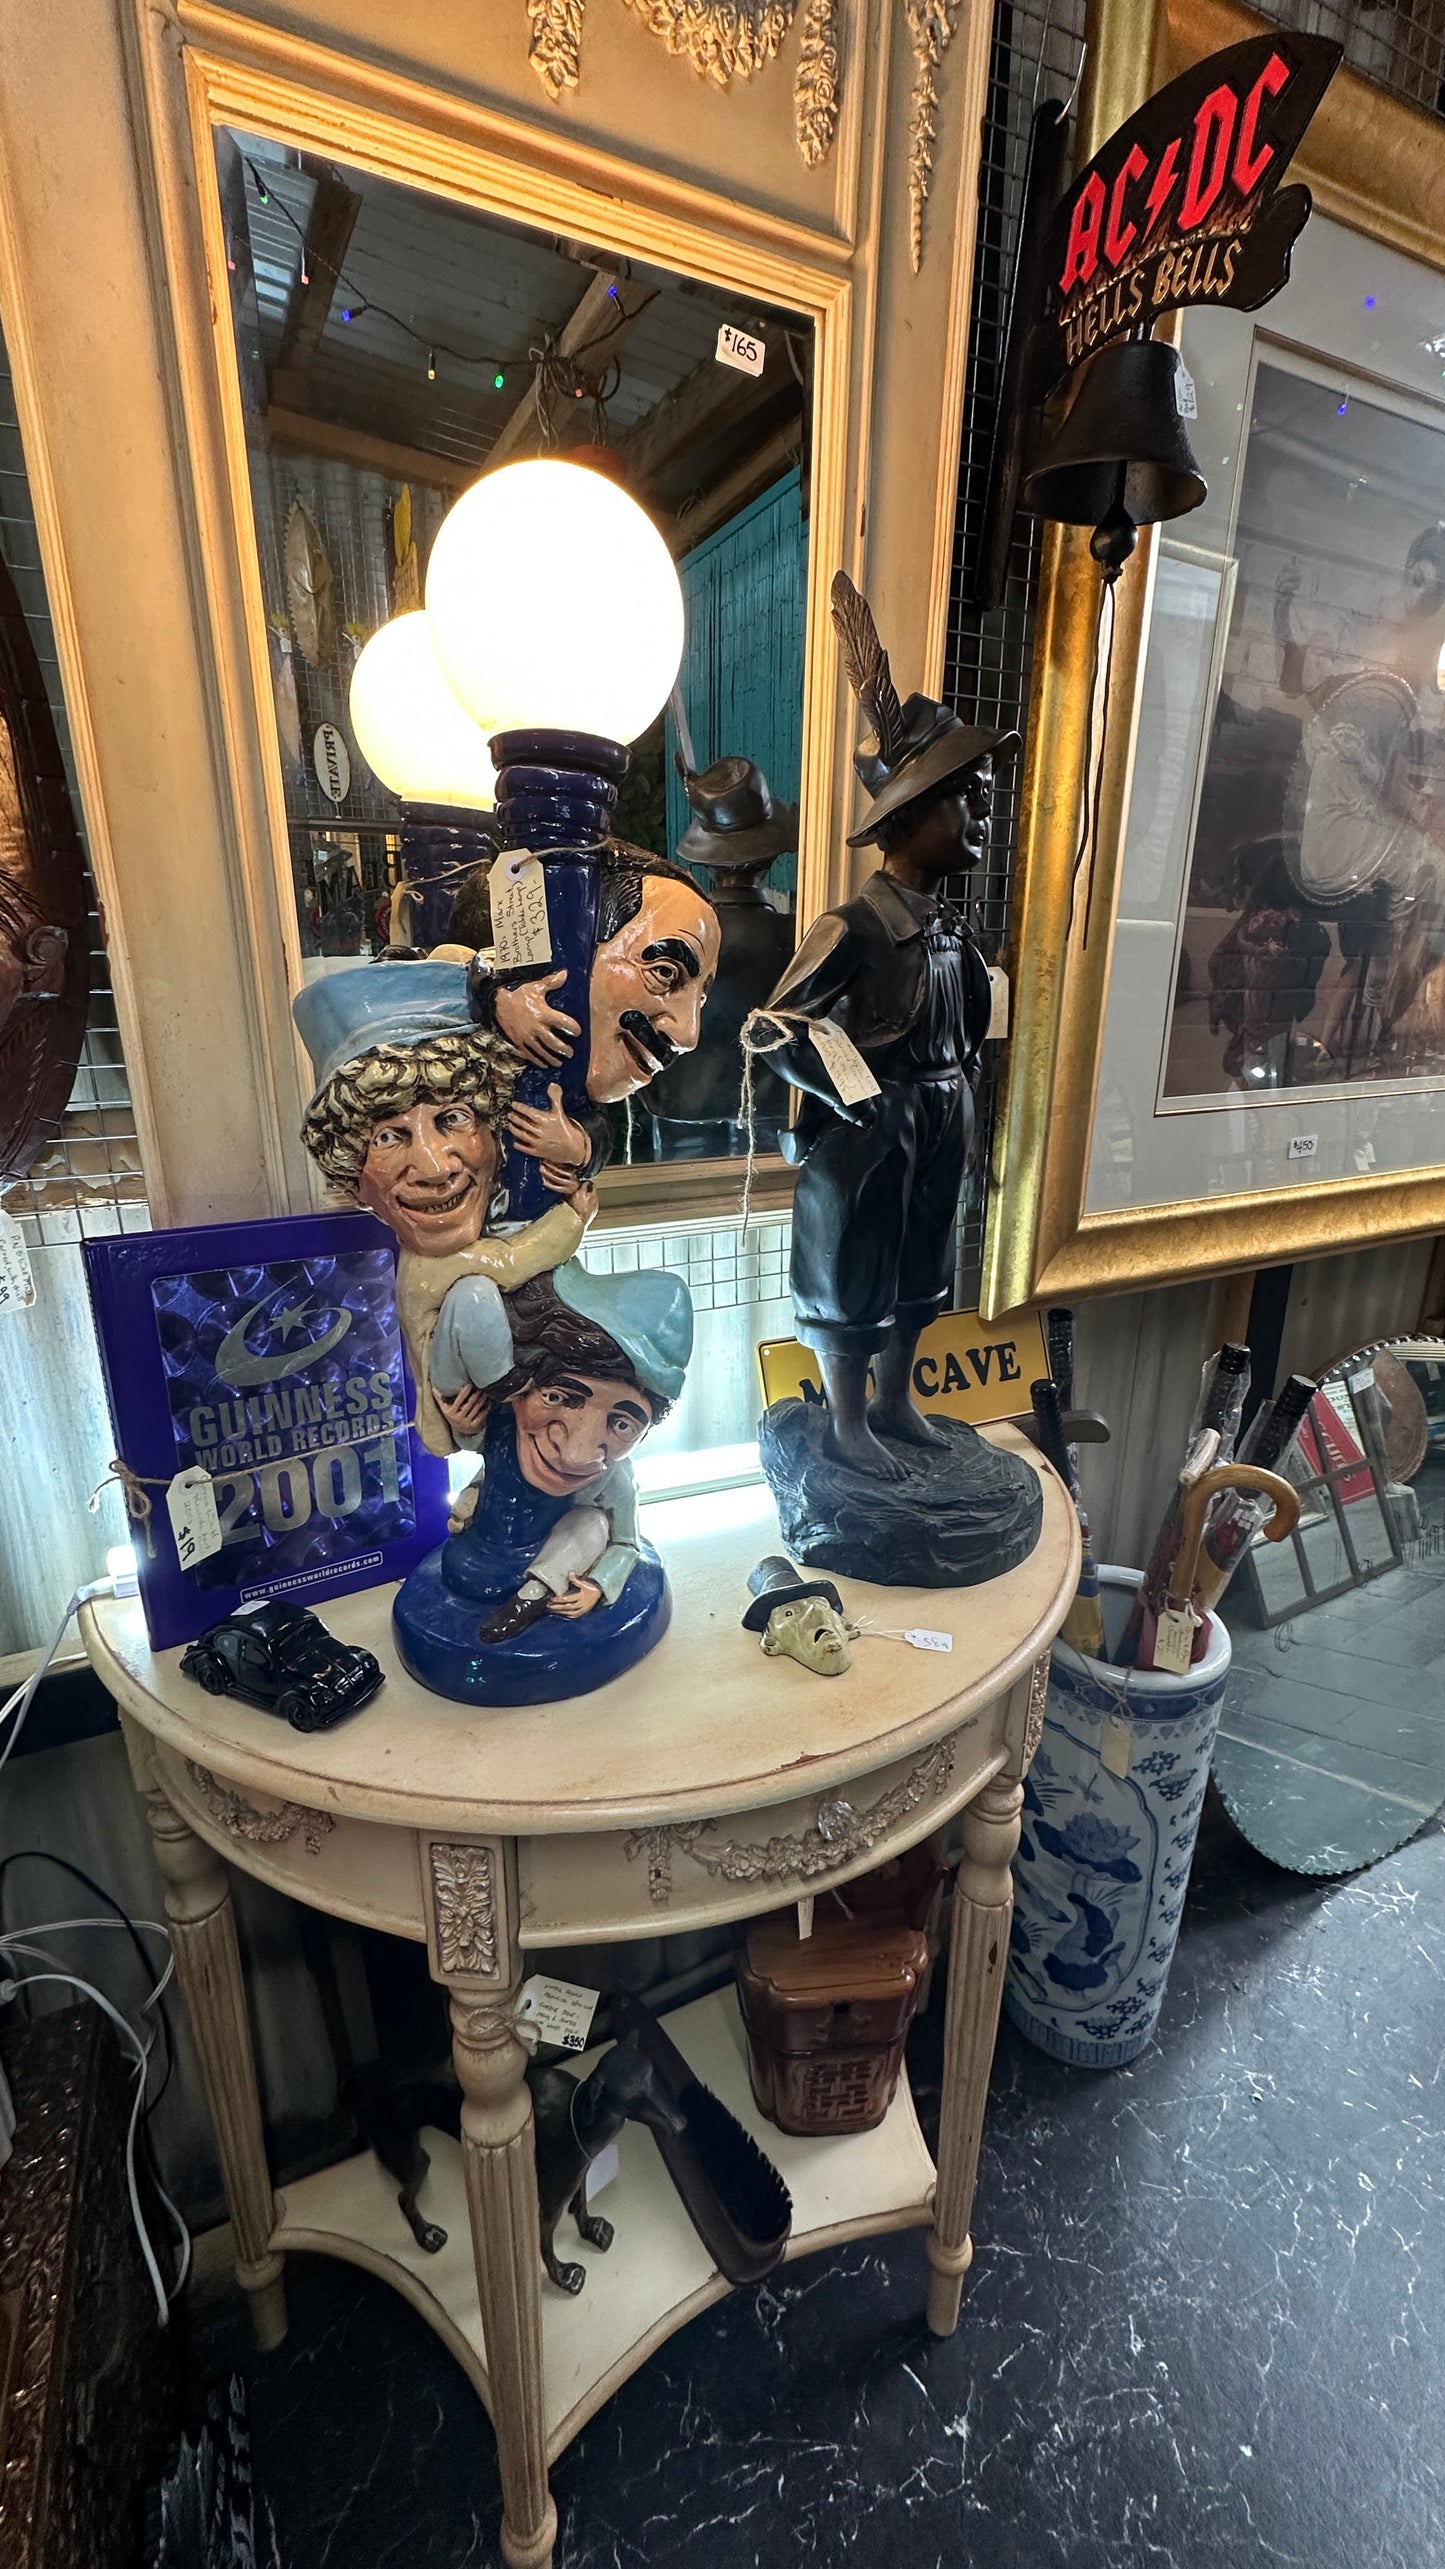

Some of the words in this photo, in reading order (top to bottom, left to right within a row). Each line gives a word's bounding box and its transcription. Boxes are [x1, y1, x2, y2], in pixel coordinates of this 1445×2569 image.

[1066, 269, 1146, 365] HELLS
[1151, 239, 1243, 305] BELLS
[725, 328, 757, 361] $165
[493, 899, 504, 929] Marx
[912, 1341, 1021, 1397] CAVE
[189, 1372, 393, 1447] GUINNESS
[195, 1434, 283, 1471] WORLD
[292, 1410, 394, 1451] RECORDS
[213, 1434, 400, 1546] 2001
[178, 1526, 195, 1561] $19
[244, 1555, 380, 1599] www.guinnessworldrecords.com
[562, 2034, 585, 2048] $350
